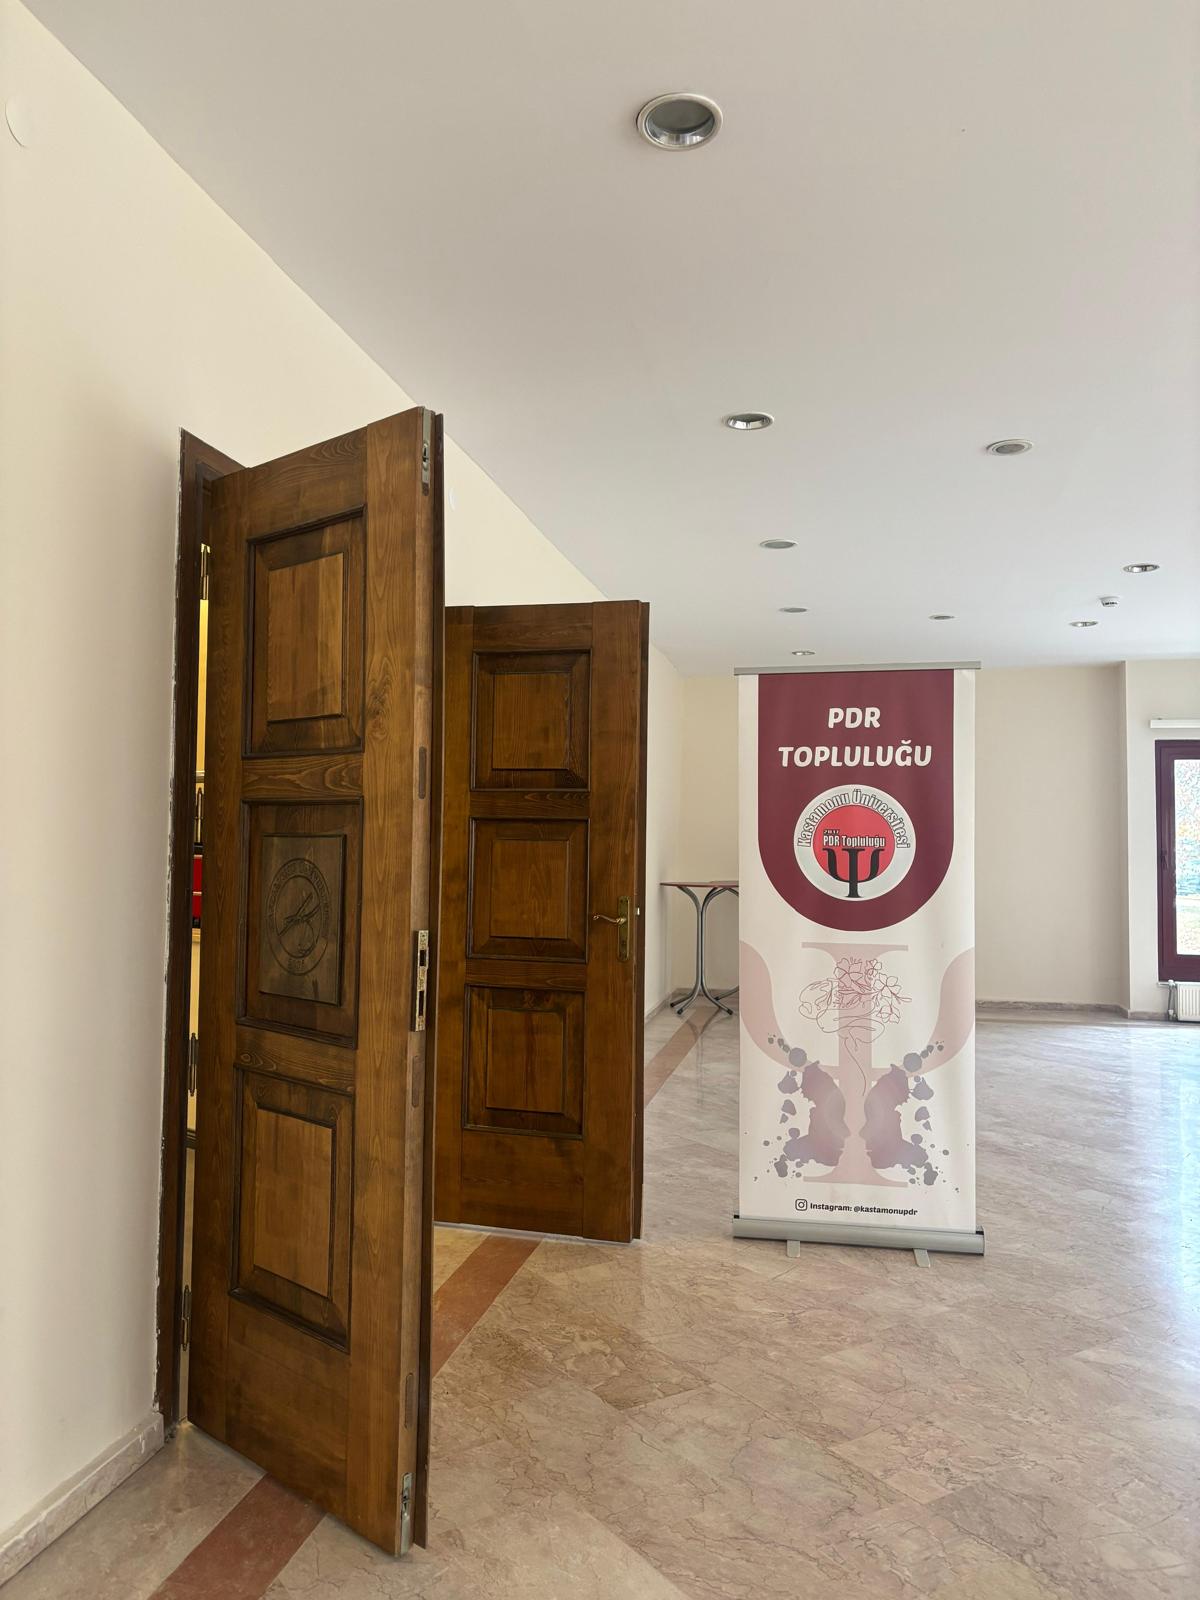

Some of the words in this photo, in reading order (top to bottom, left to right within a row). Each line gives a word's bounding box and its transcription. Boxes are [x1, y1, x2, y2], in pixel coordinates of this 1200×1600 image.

[828, 707, 881, 728] PDR
[778, 739, 932, 767] TOPLULUĞU
[797, 792, 850, 848] Kastamonu
[851, 788, 911, 849] Üniversitesi
[823, 835, 840, 846] PDR
[841, 835, 886, 848] Topluluğu
[810, 1202, 852, 1212] Instagram:
[853, 1205, 918, 1216] @kastamonupdr
